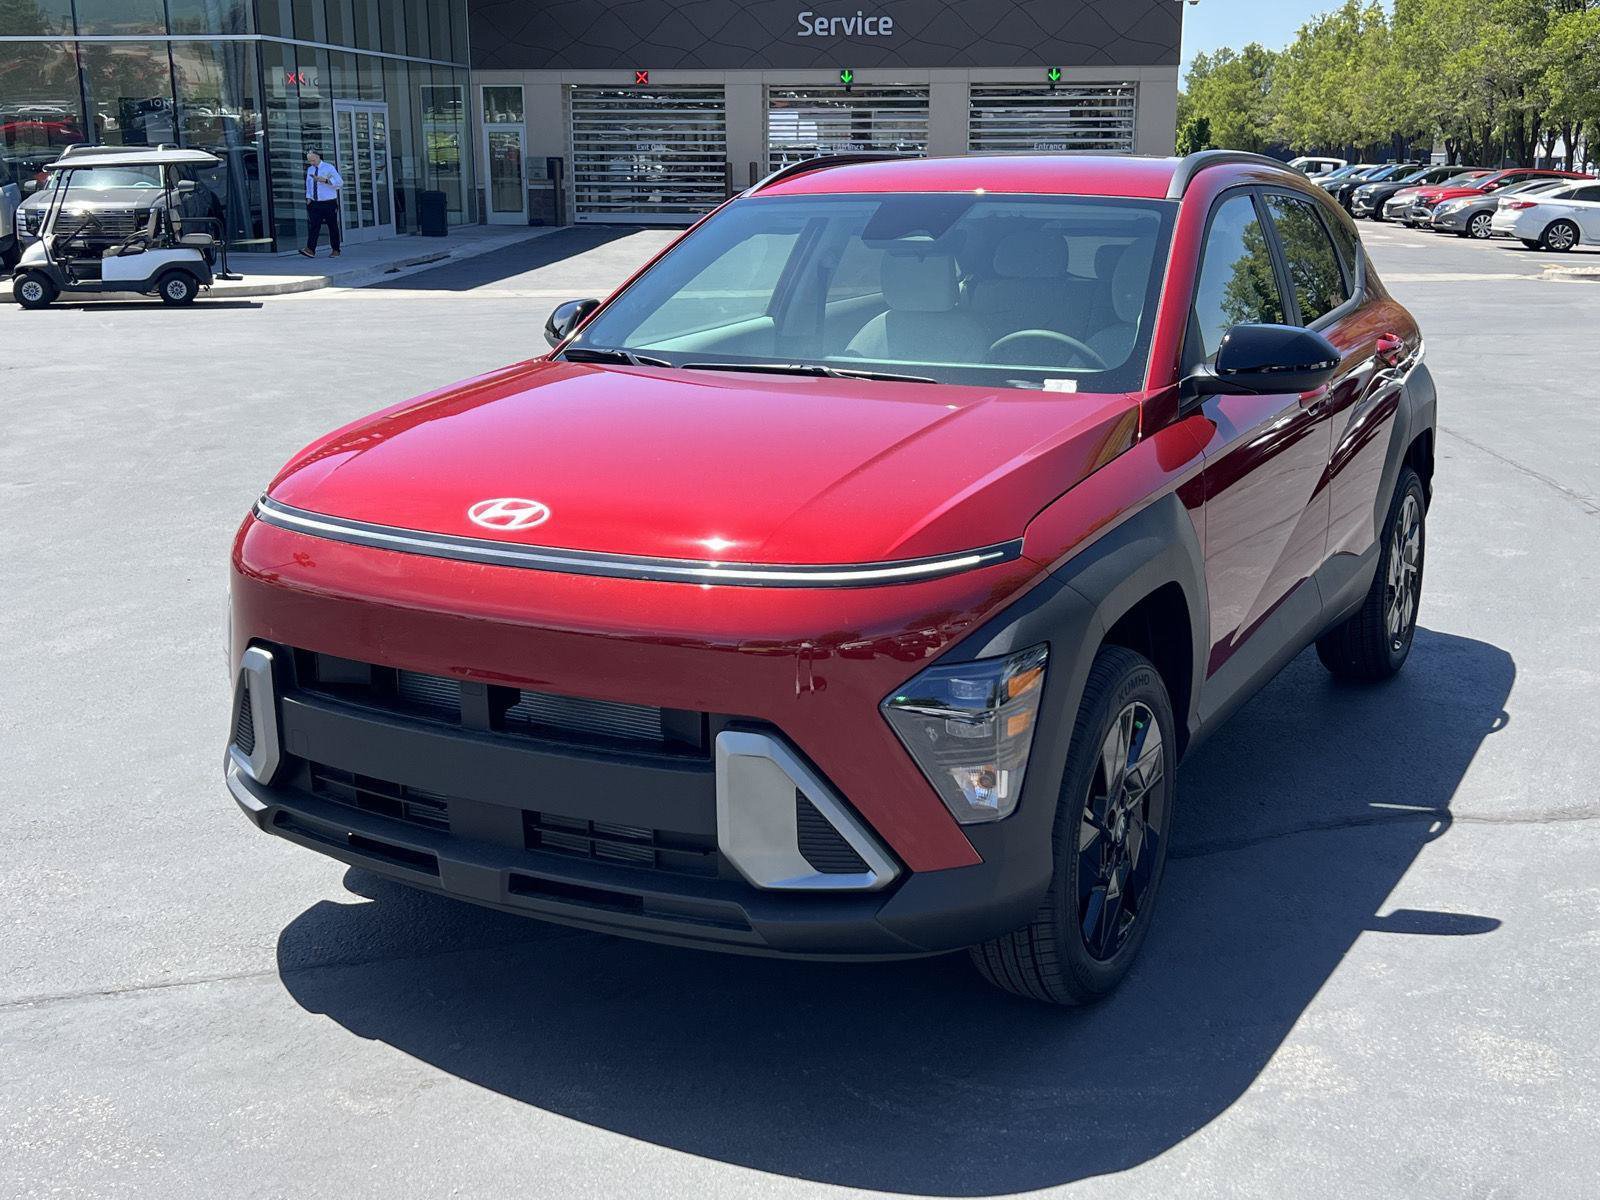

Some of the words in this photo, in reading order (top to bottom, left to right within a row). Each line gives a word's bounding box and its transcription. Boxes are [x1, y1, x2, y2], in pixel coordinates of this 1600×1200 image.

[797, 10, 893, 36] Service
[832, 142, 865, 151] Entrance
[1033, 142, 1067, 151] Entrance
[1117, 673, 1150, 704] KUMHO
